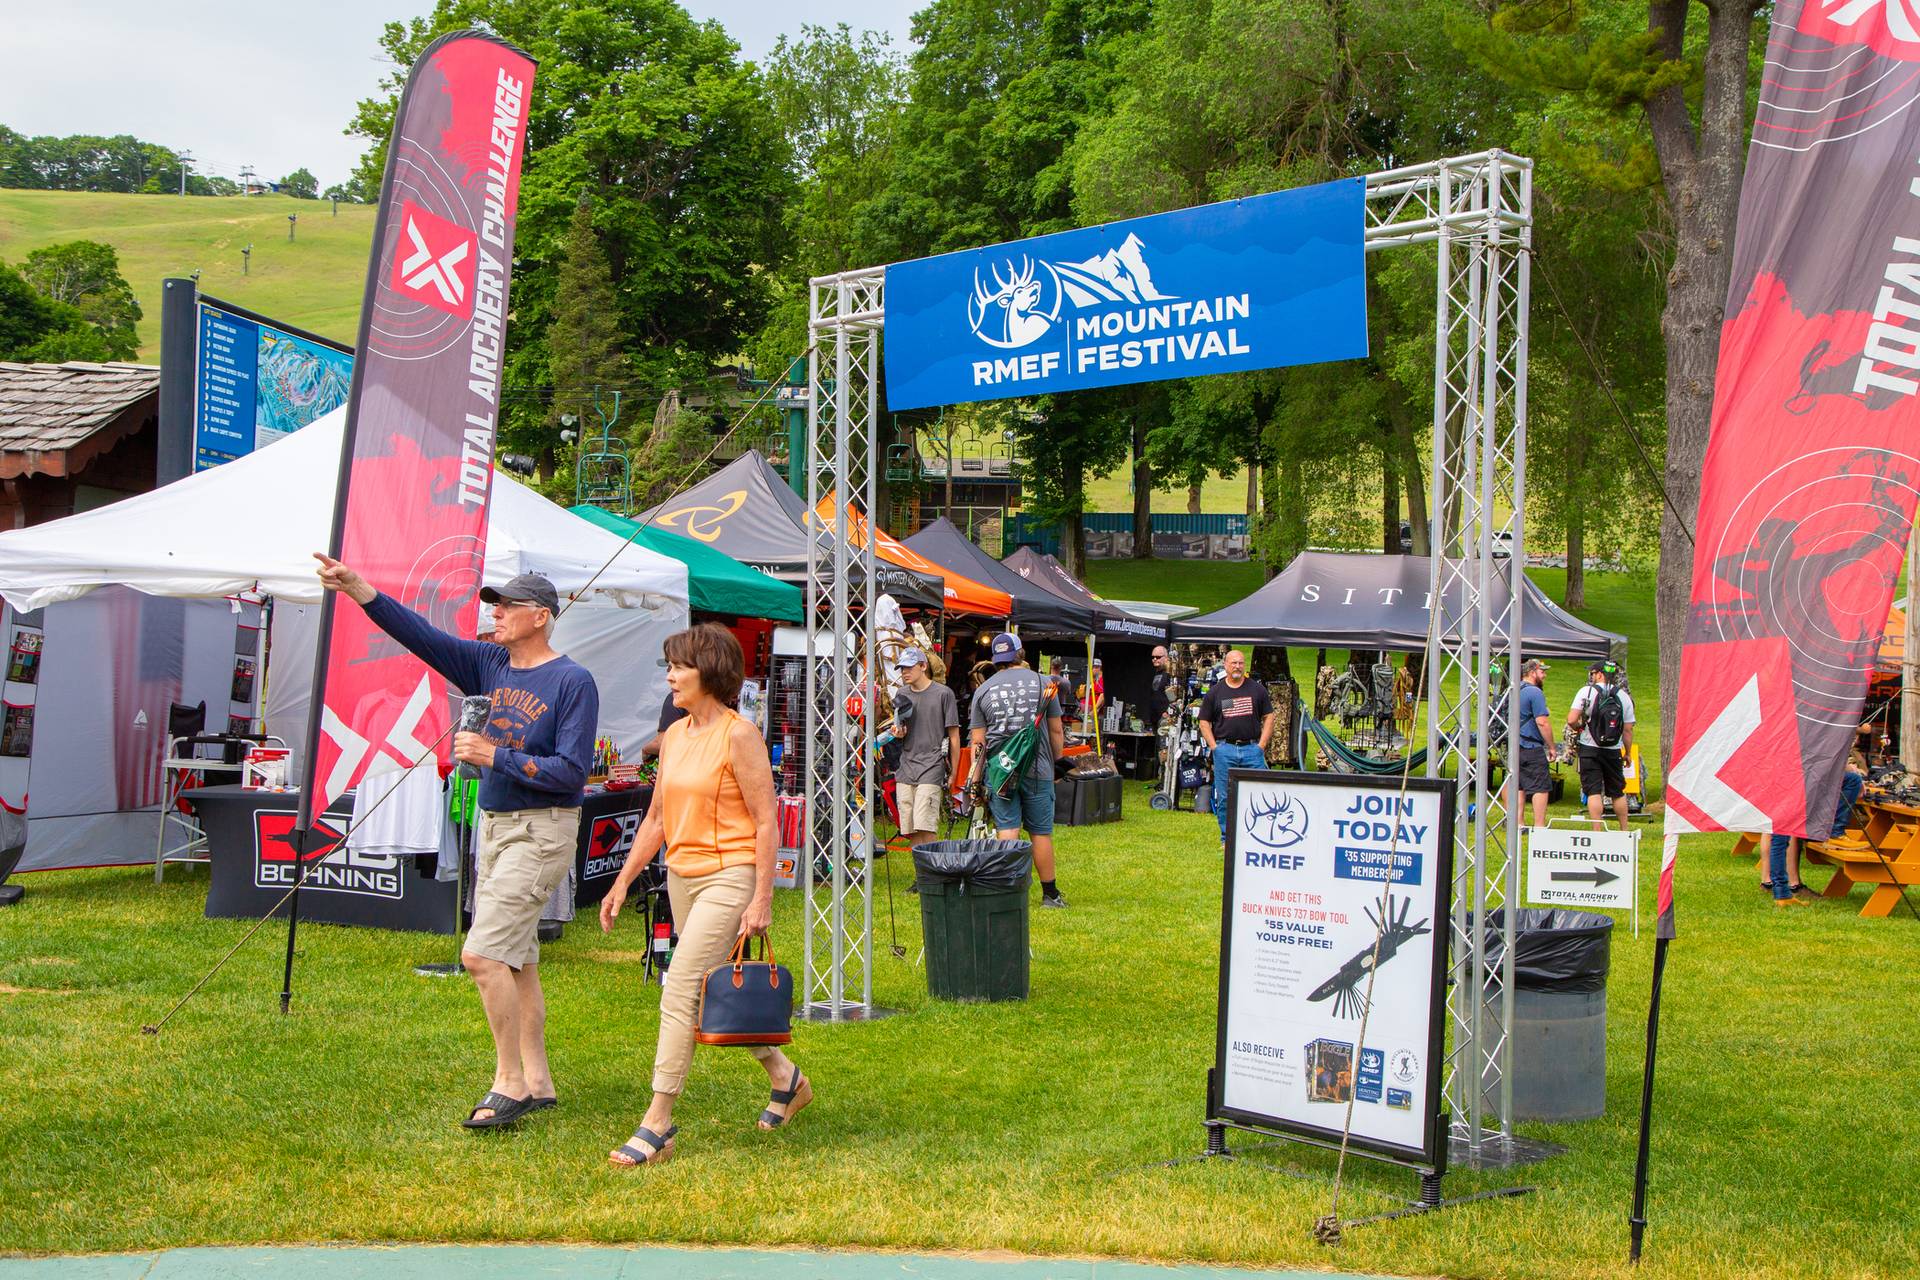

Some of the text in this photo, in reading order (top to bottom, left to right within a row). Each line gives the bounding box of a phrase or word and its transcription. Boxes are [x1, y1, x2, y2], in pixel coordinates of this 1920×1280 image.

[458, 67, 523, 506] TOTAL ARCHERY CHALLENGE
[1076, 293, 1250, 341] MOUNTAIN
[1077, 328, 1250, 374] FESTIVAL
[971, 352, 1061, 387] RMEF
[503, 687, 548, 721] ROYALE
[1346, 795, 1414, 817] JOIN
[1333, 820, 1428, 845] TODAY
[1570, 836, 1591, 847] TO
[1245, 851, 1305, 871] RMEF
[1344, 850, 1413, 867] $35 SUPPORTING
[1532, 850, 1630, 863] REGISTRATION
[260, 863, 398, 893] BOHNING
[1351, 867, 1404, 880] MEMBERSHIP
[1269, 890, 1322, 905] AND GET THIS
[1579, 893, 1619, 901] ARCHERY
[1242, 902, 1349, 925] BUCK KNIVES 737 BOW TOOL
[1265, 919, 1325, 935] $55 VALUE
[1256, 931, 1333, 950] YOURS FREE!
[1232, 1041, 1285, 1059] ALSO RECEIVE
